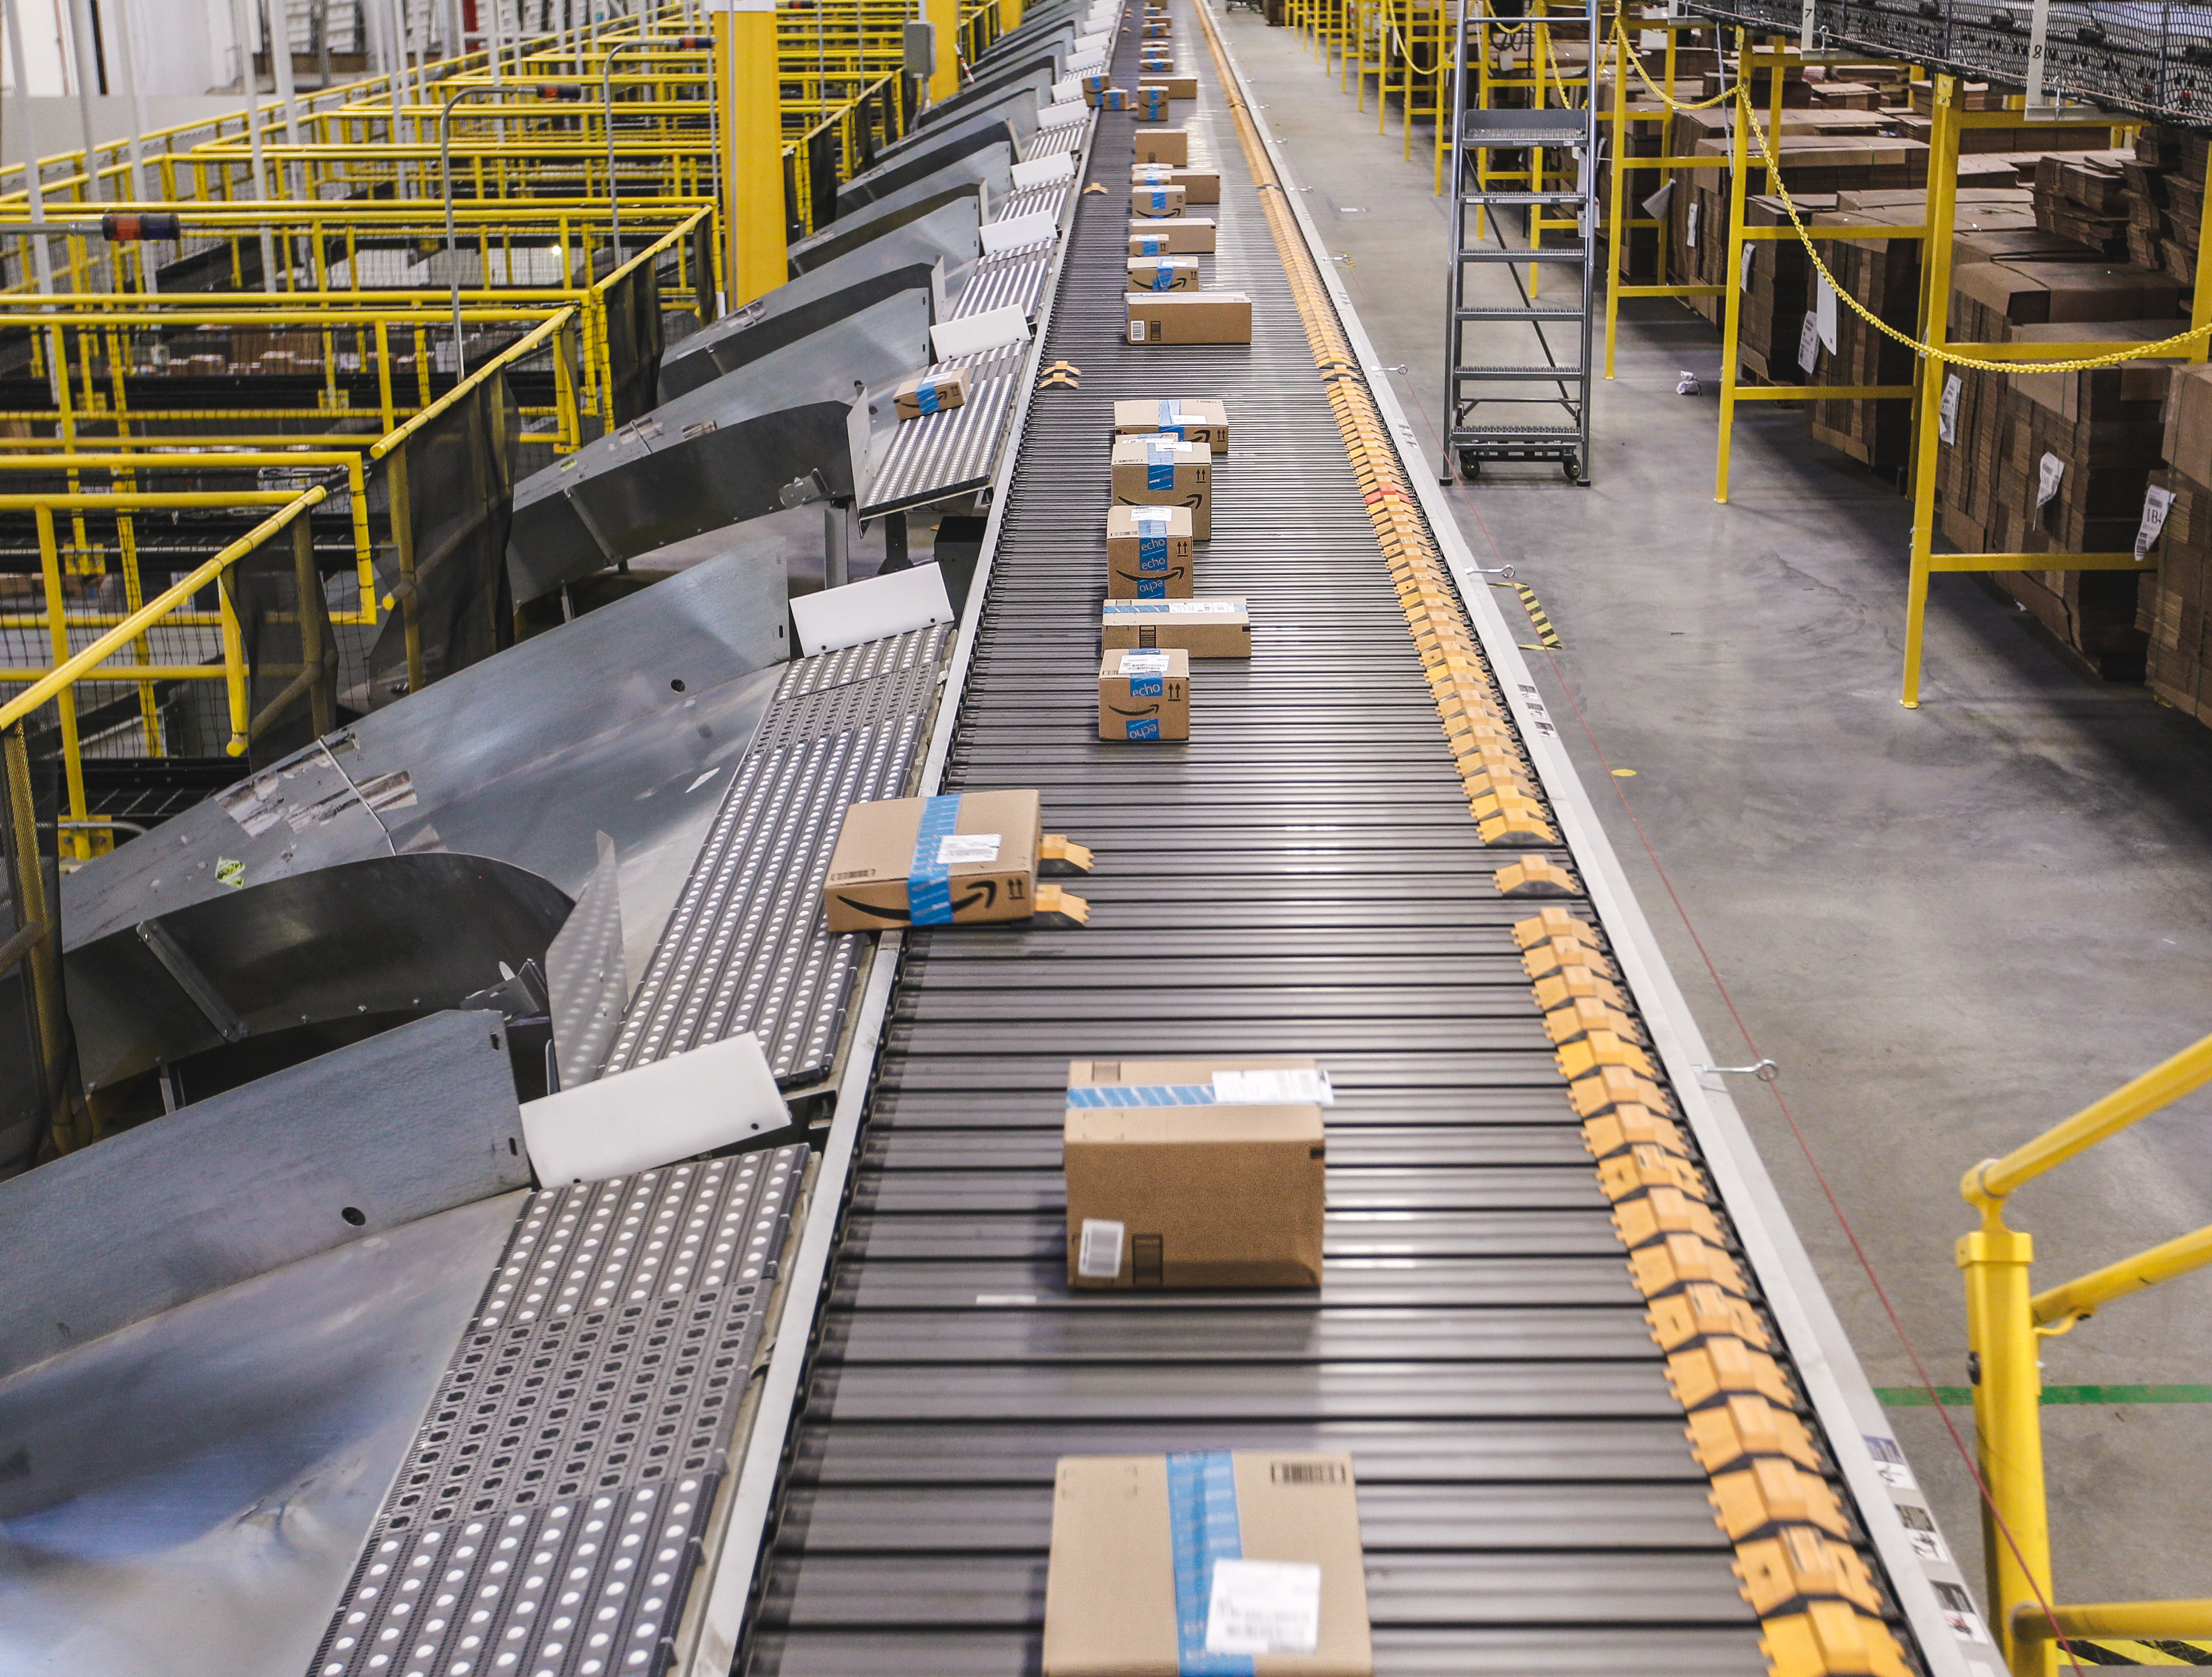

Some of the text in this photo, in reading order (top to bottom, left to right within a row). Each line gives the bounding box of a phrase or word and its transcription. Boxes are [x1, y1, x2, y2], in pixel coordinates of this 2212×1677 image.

[1805, 8, 1813, 18] 7
[2032, 44, 2042, 59] 8
[1141, 538, 1165, 551] echo
[1142, 557, 1165, 570] echo
[1139, 580, 1163, 592] echo
[1132, 683, 1161, 697] echo
[1129, 723, 1157, 739] echo
